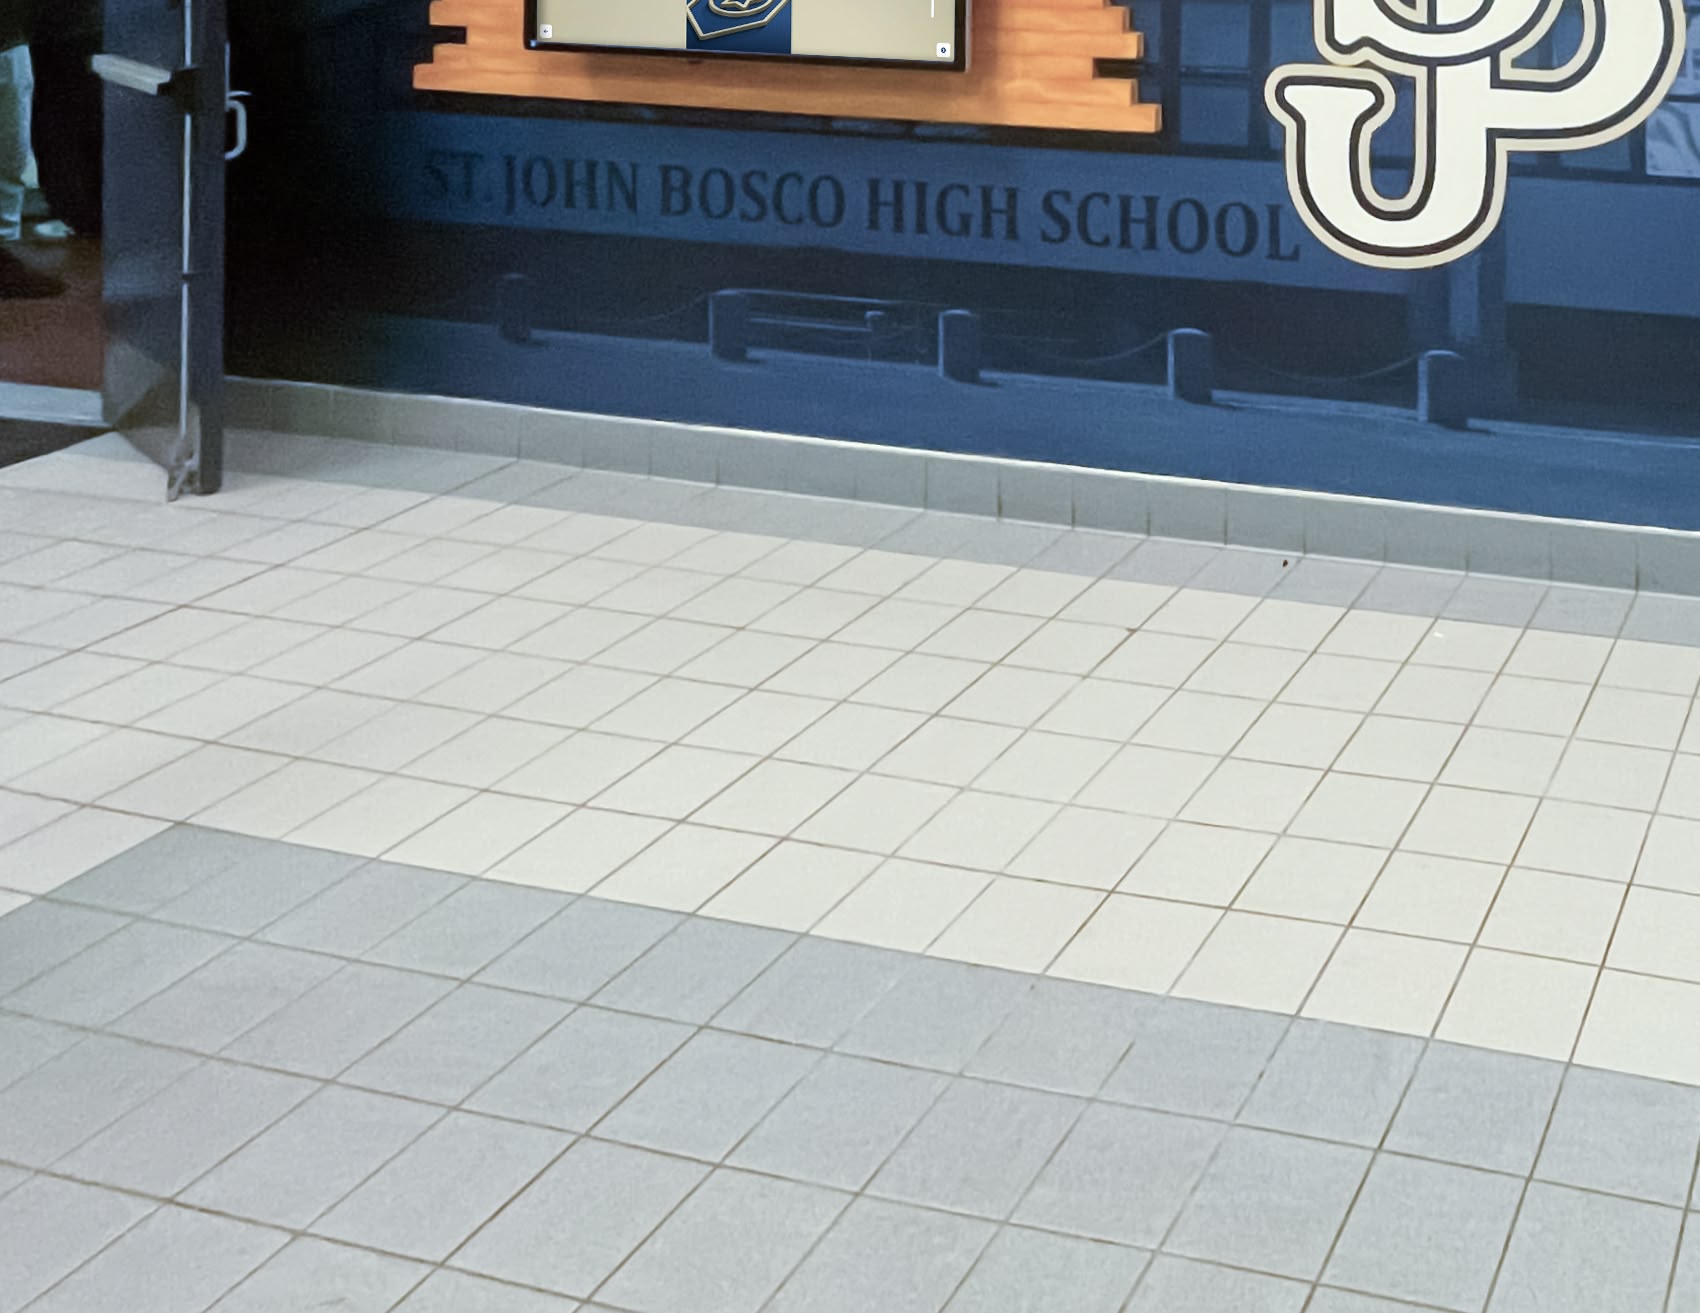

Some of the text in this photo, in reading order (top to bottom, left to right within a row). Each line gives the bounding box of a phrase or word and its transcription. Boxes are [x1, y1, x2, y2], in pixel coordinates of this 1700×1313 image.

[503, 154, 642, 215] JOHN
[658, 163, 846, 230] BOSCO
[866, 178, 1021, 242] HIGH
[1040, 189, 1301, 264] SCHOOL
